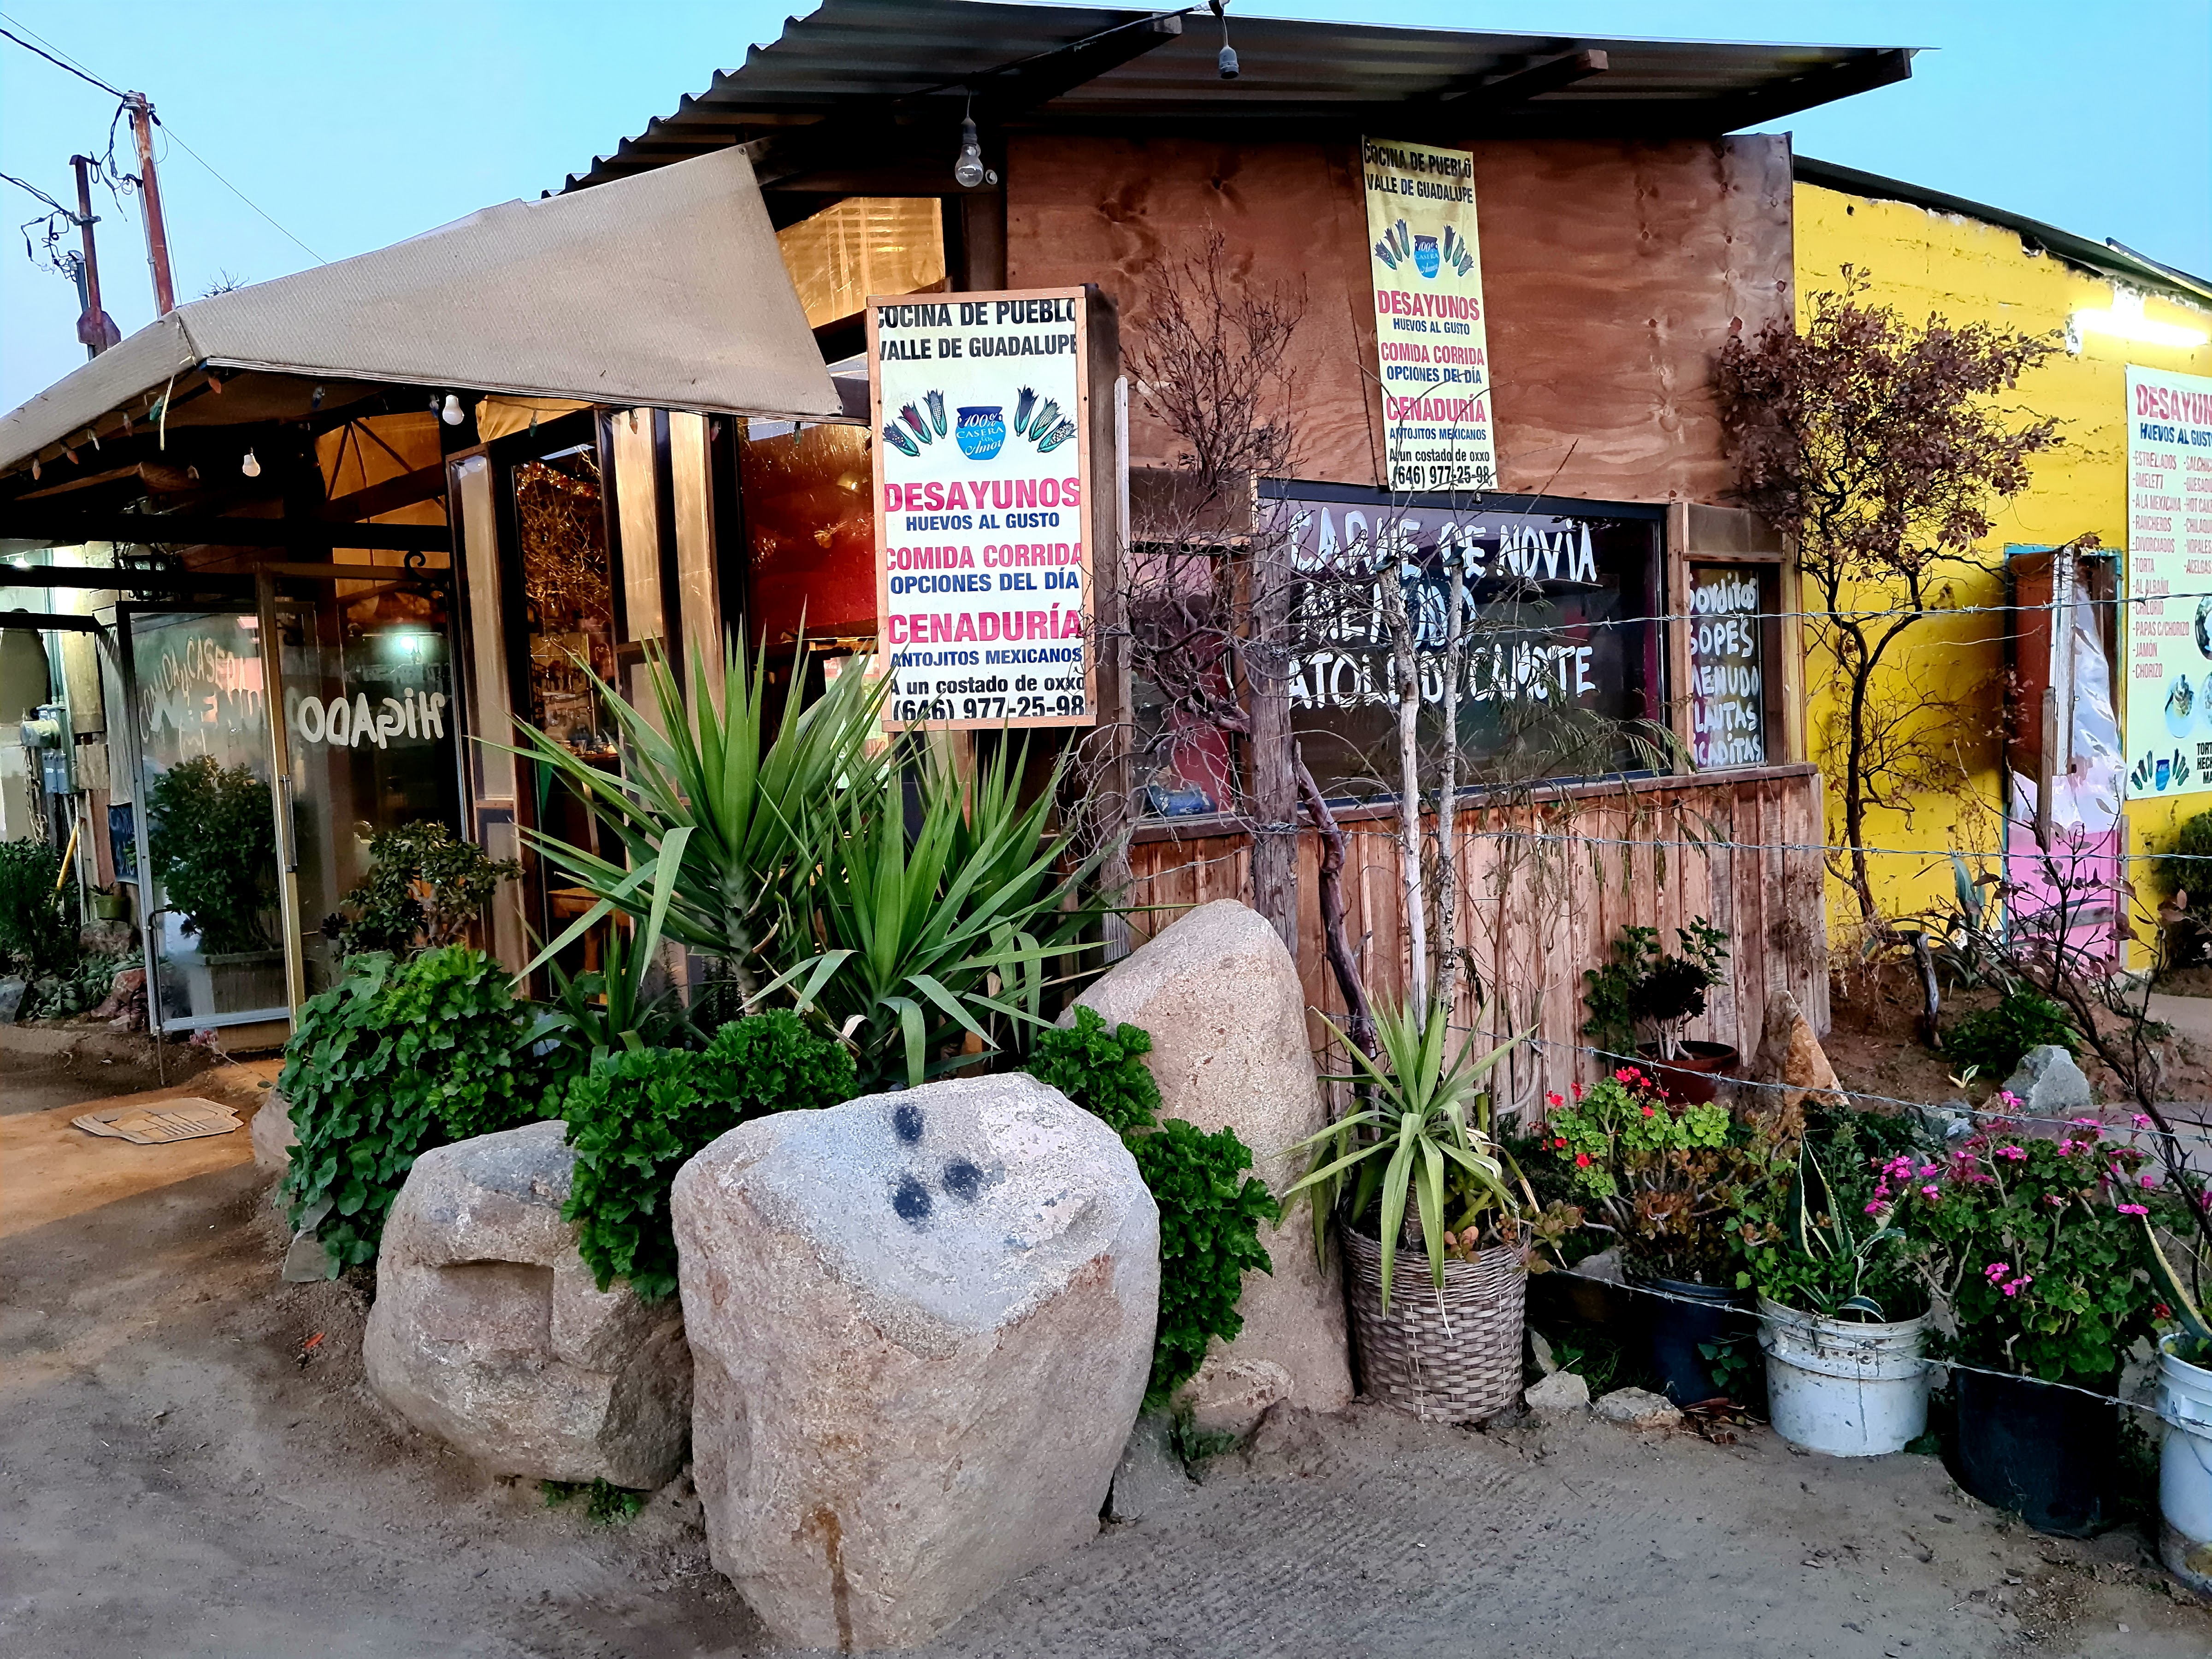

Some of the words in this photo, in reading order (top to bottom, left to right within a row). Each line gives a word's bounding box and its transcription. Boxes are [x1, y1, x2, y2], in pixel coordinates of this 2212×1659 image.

[1363, 139, 1406, 169] COCINA
[1410, 152, 1425, 172] DE
[1428, 154, 1471, 178] PUEBLO
[1366, 173, 1398, 194] VALLE
[1401, 178, 1414, 196] DE
[1417, 181, 1473, 204] GUADALUPE
[961, 302, 987, 325] DE
[997, 299, 1075, 325] PUEBLO
[1377, 290, 1480, 320] DESAYUNOS
[1393, 318, 1427, 332] HUEVOS
[1430, 321, 1441, 333] AL
[1444, 322, 1470, 335] GUSTO
[880, 339, 931, 360] VALLE
[938, 338, 962, 358] DE
[969, 335, 1076, 357] GUADALUPE
[1381, 342, 1429, 363] COMIDA
[1433, 346, 1484, 366] CORRIDA
[1387, 366, 1439, 382] OPCIONES
[1444, 368, 1462, 383] DEL
[1465, 367, 1482, 384] DÍA
[964, 413, 997, 427] 100%
[1386, 394, 1486, 422] CENADURÍA
[956, 426, 1003, 438] CASERA
[1390, 427, 1436, 439] ANTOJITOS
[1439, 428, 1486, 440] MEXICANOS
[2141, 423, 2175, 443] HUEVOS
[2177, 428, 2189, 445] AL
[2191, 430, 2212, 447] GUST
[965, 440, 1003, 455] Amor
[1389, 448, 1397, 462] A
[1400, 451, 1412, 461] un
[1415, 448, 1451, 462] costado
[1456, 448, 1466, 462] de
[1470, 451, 1490, 462] oxxo
[1393, 466, 1425, 489] (646)
[1429, 466, 1490, 484] 977-25-98
[885, 478, 1079, 512] DESAYUNOS
[2135, 494, 2140, 509] A
[906, 515, 973, 531] HUEVOS
[979, 514, 1000, 529] AL
[1006, 513, 1059, 528] GUSTO
[886, 546, 975, 570] COMIDA
[984, 543, 1082, 567] CORRIDA
[1437, 521, 1487, 578] DE
[2135, 558, 2155, 573] TORTA
[891, 573, 991, 594] OPCIONES
[1000, 573, 1037, 591] DEL
[1045, 567, 1079, 590] DÍA
[2135, 579, 2144, 594] AL
[889, 603, 1084, 644] CENADURÍA
[2135, 621, 2156, 637] PAPAS
[1691, 619, 1754, 658] SOPES
[890, 650, 979, 667] ANTOJITOS
[986, 647, 1083, 664] MEXICANOS
[1420, 650, 1463, 703] D
[2135, 663, 2163, 679] CHORIZO
[907, 682, 929, 695] un
[936, 675, 1008, 694] costado
[1015, 674, 1037, 691] de
[1044, 677, 1084, 691] oxxo
[893, 699, 955, 720] (646)
[963, 695, 1085, 719] 977-25-98
[1694, 700, 1758, 734] LAUTAS
